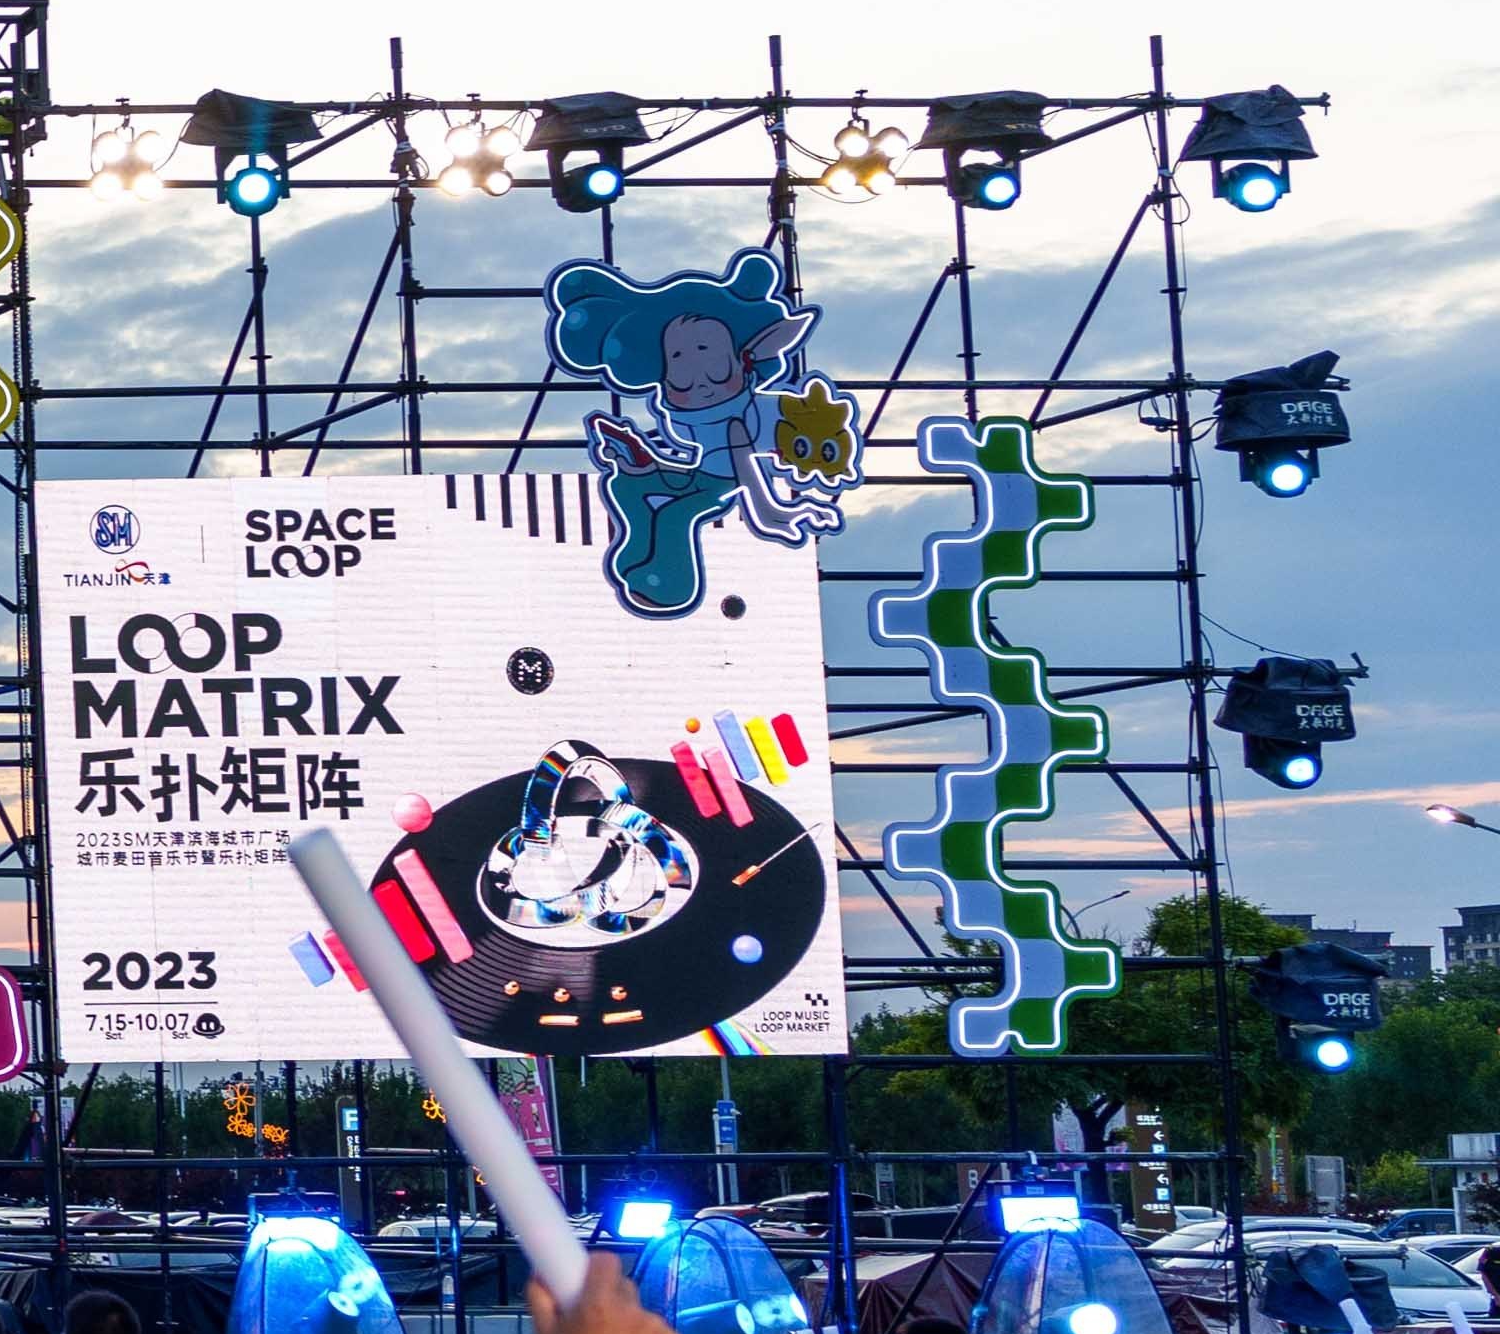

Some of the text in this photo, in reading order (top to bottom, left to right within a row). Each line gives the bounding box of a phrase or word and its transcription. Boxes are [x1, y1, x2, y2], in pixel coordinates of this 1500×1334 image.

[1280, 401, 1333, 414] DAGE
[95, 511, 133, 548] SM
[246, 508, 397, 543] SPACE
[246, 544, 362, 579] LOOP
[63, 572, 172, 587] TIANJIN 天津
[69, 612, 284, 675] LOOP
[73, 675, 404, 740] MATRIX
[1295, 704, 1346, 716] DAGE
[74, 747, 365, 823] 乐扑矩阵
[76, 830, 291, 848] 2023SM天津滨海城市广场
[82, 951, 218, 991] 2023
[1323, 992, 1372, 1006] DAGE
[86, 1014, 190, 1033] 7.15-10.07
[763, 1010, 830, 1021] LOOP MUSIC
[754, 1022, 831, 1033] LOOP MARKET
